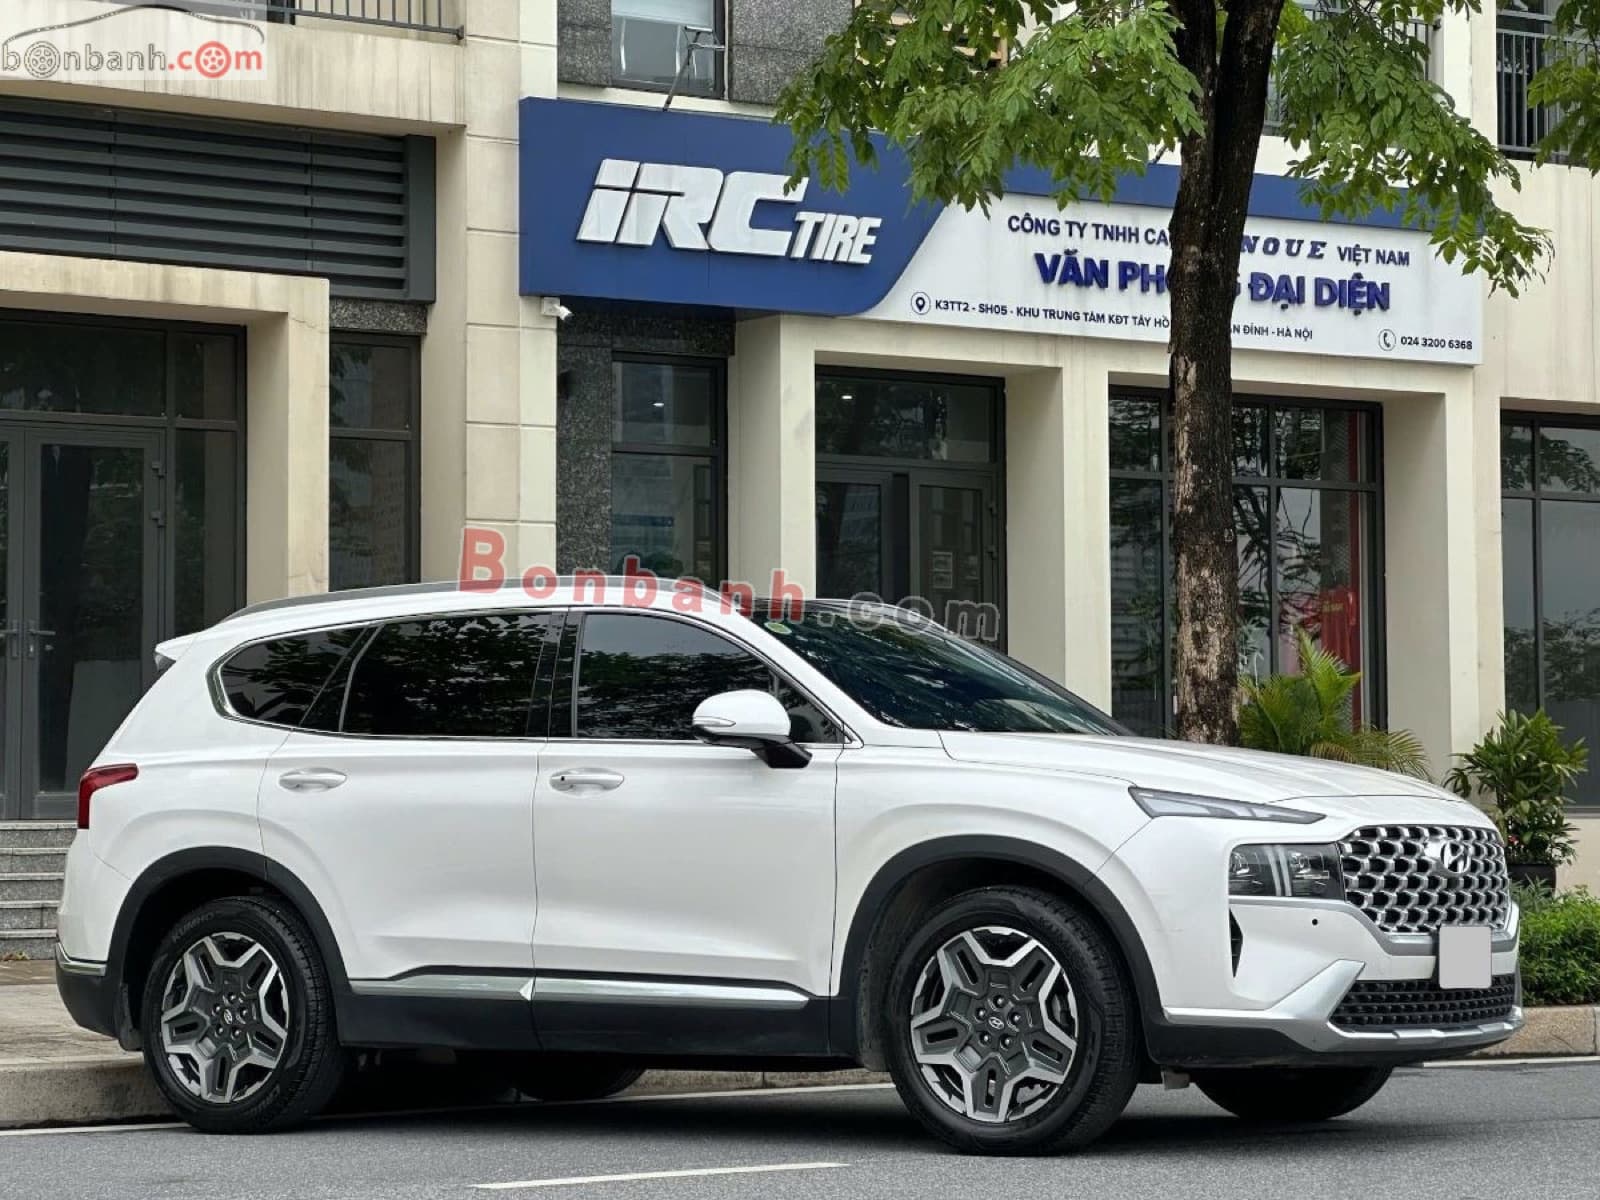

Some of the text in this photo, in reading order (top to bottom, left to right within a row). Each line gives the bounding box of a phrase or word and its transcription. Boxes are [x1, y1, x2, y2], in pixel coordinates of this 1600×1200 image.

[789, 211, 883, 264] TIRE
[1008, 212, 1060, 237] CÔNG
[1065, 220, 1088, 239] TY
[1092, 223, 1139, 244] TNHH
[1240, 235, 1328, 259] NOUE
[1337, 243, 1372, 266] VIỆT
[1376, 249, 1410, 266] NAM
[1034, 249, 1109, 289] VĂN
[1248, 271, 1306, 310] ĐẠI
[1314, 272, 1390, 315] DIỆN
[935, 300, 969, 312] K3TT2
[978, 303, 1008, 315] SH05
[1016, 306, 1040, 318] KHU
[1042, 308, 1081, 321] TRUNG
[1082, 310, 1105, 324] TÂM
[1108, 314, 1129, 325] KĐT
[1131, 315, 1151, 327] TÂY
[1276, 326, 1292, 338] HÀ
[1294, 326, 1313, 341] NỘI
[1400, 336, 1473, 350] 024 3200 6368
